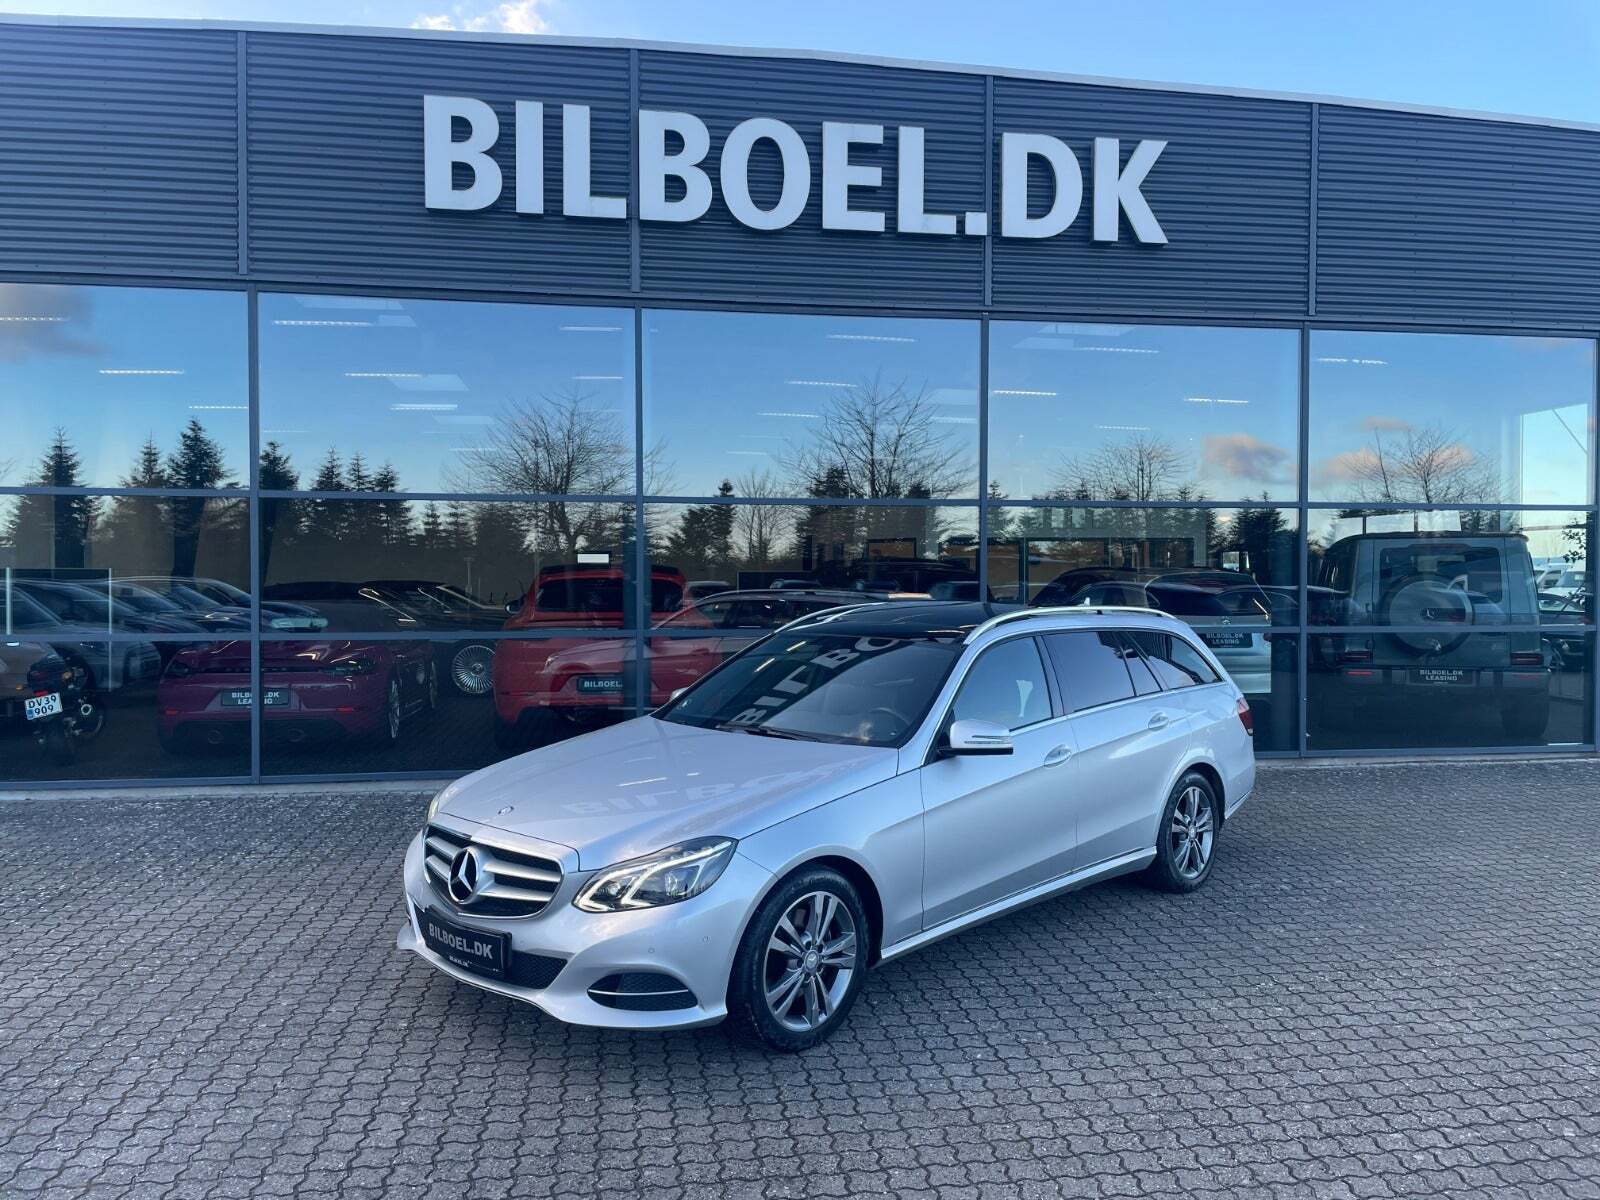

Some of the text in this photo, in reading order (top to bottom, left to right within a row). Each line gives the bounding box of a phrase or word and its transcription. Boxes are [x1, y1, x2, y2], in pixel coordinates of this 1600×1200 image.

[424, 95, 1168, 244] BILBOEL.DK
[583, 680, 624, 688] BILBOEL.
[34, 704, 54, 716] 909
[428, 922, 494, 960] BILBOEL.DK
